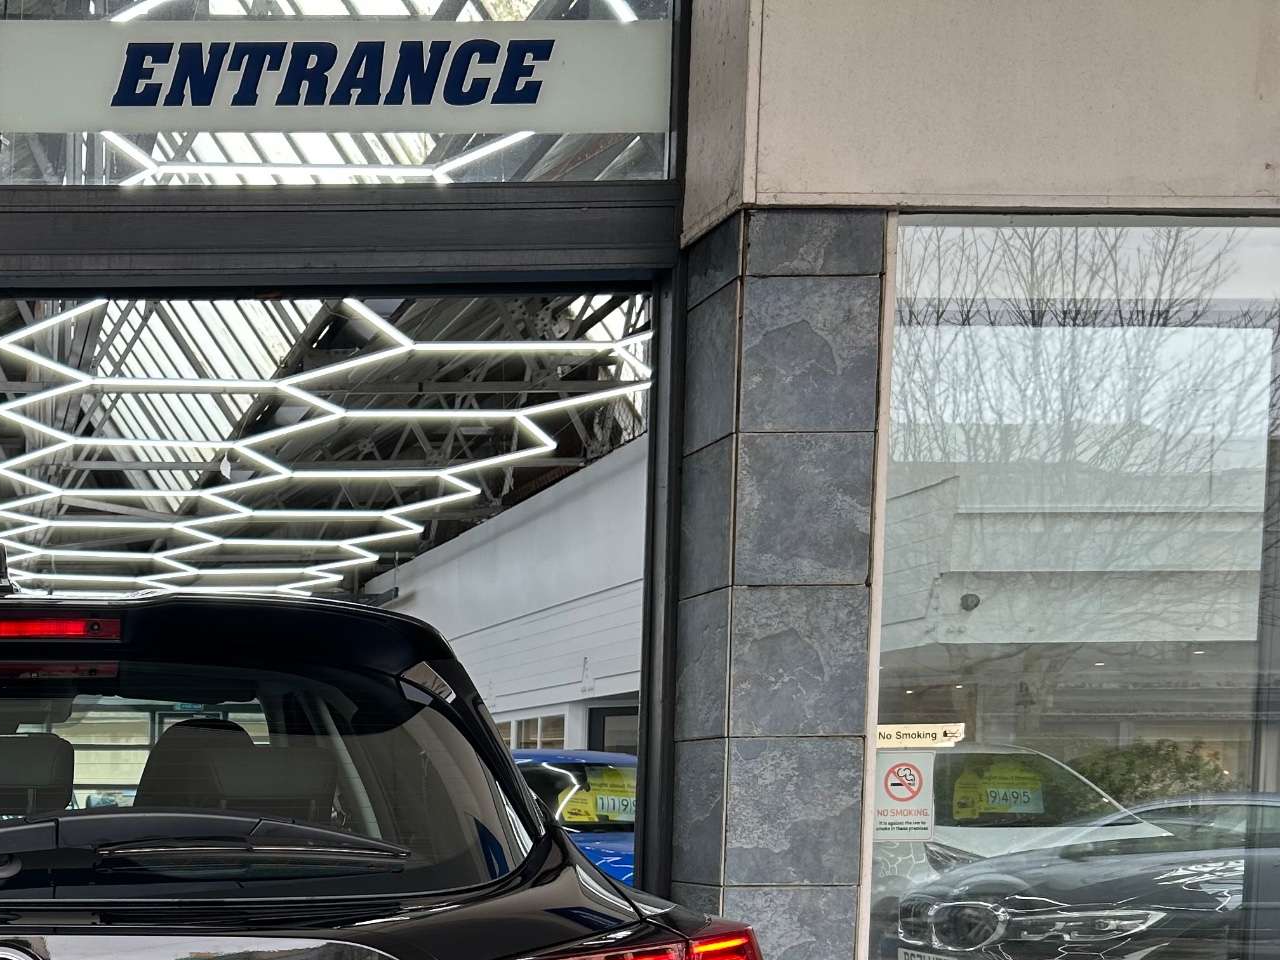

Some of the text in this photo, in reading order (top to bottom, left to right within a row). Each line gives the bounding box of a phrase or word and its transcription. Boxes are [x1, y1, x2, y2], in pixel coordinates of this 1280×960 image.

[109, 38, 556, 107] ENTRANCE
[878, 731, 937, 740] No Smoking
[876, 808, 889, 817] NO
